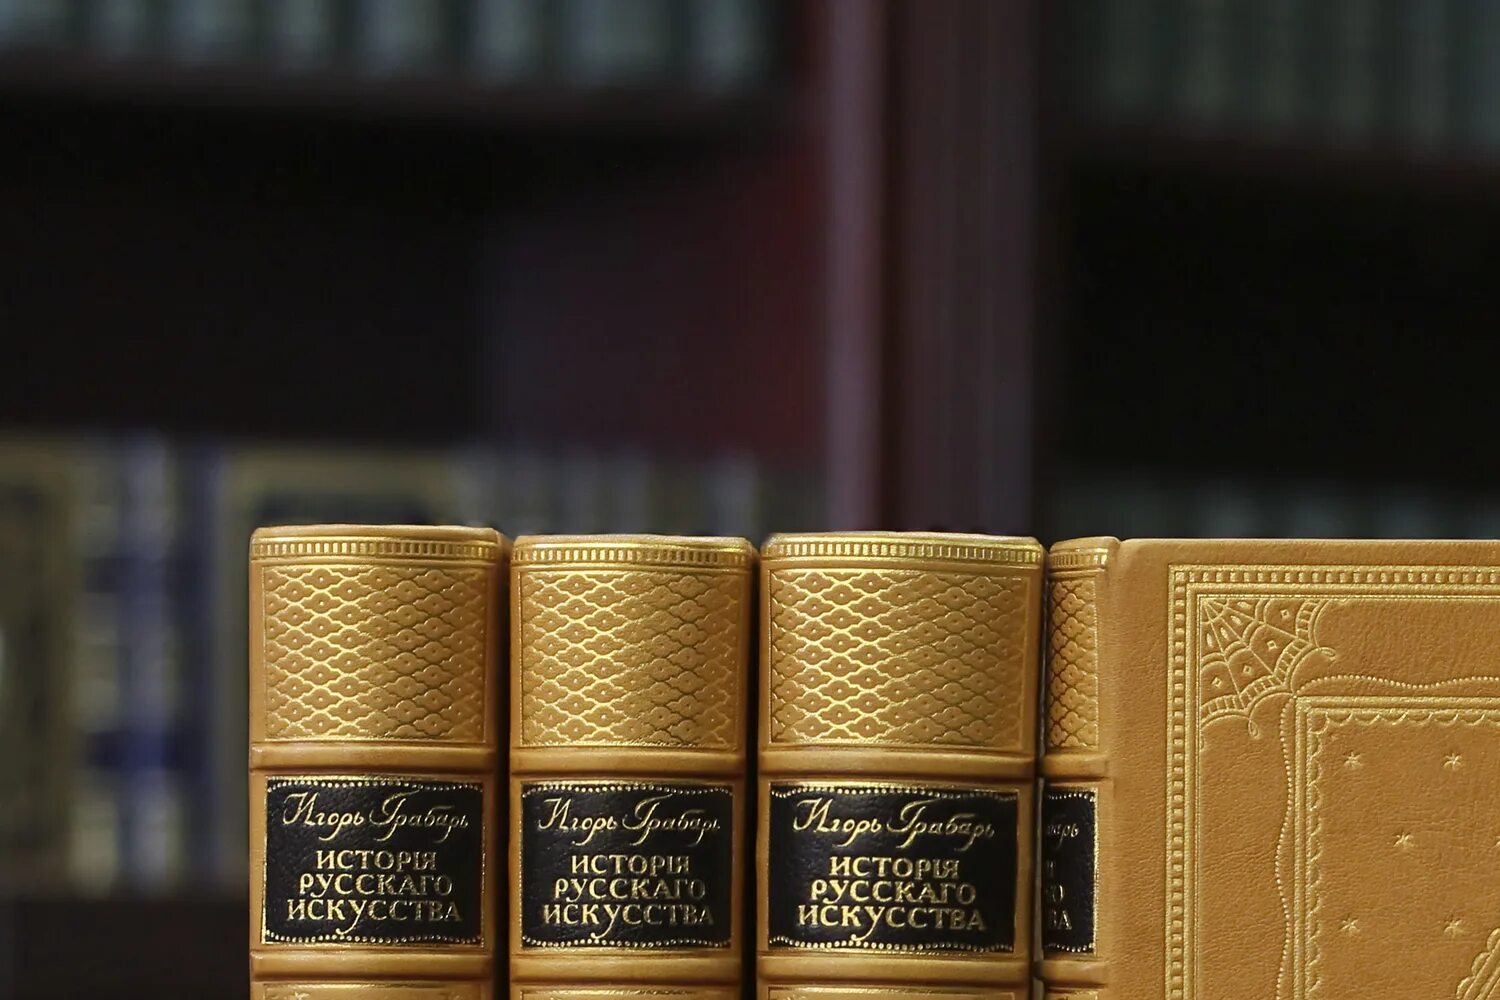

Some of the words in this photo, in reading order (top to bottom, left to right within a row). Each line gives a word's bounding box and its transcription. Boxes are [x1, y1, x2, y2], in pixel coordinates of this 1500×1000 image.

[282, 792, 364, 842] Игорь
[369, 790, 469, 843] Грабарь
[538, 797, 617, 847] Игорь
[621, 793, 721, 847] Грабарь
[792, 798, 882, 848] Игорь
[886, 800, 995, 851] Грабарь
[299, 874, 453, 899] РУССКАГО
[554, 879, 706, 902] РУССКАГО
[810, 879, 976, 905] РУССКАГО
[286, 899, 463, 934] ИСКУССТВА
[542, 903, 714, 939] ИСКУССТВА
[798, 905, 986, 942] ИСКУССТВА
